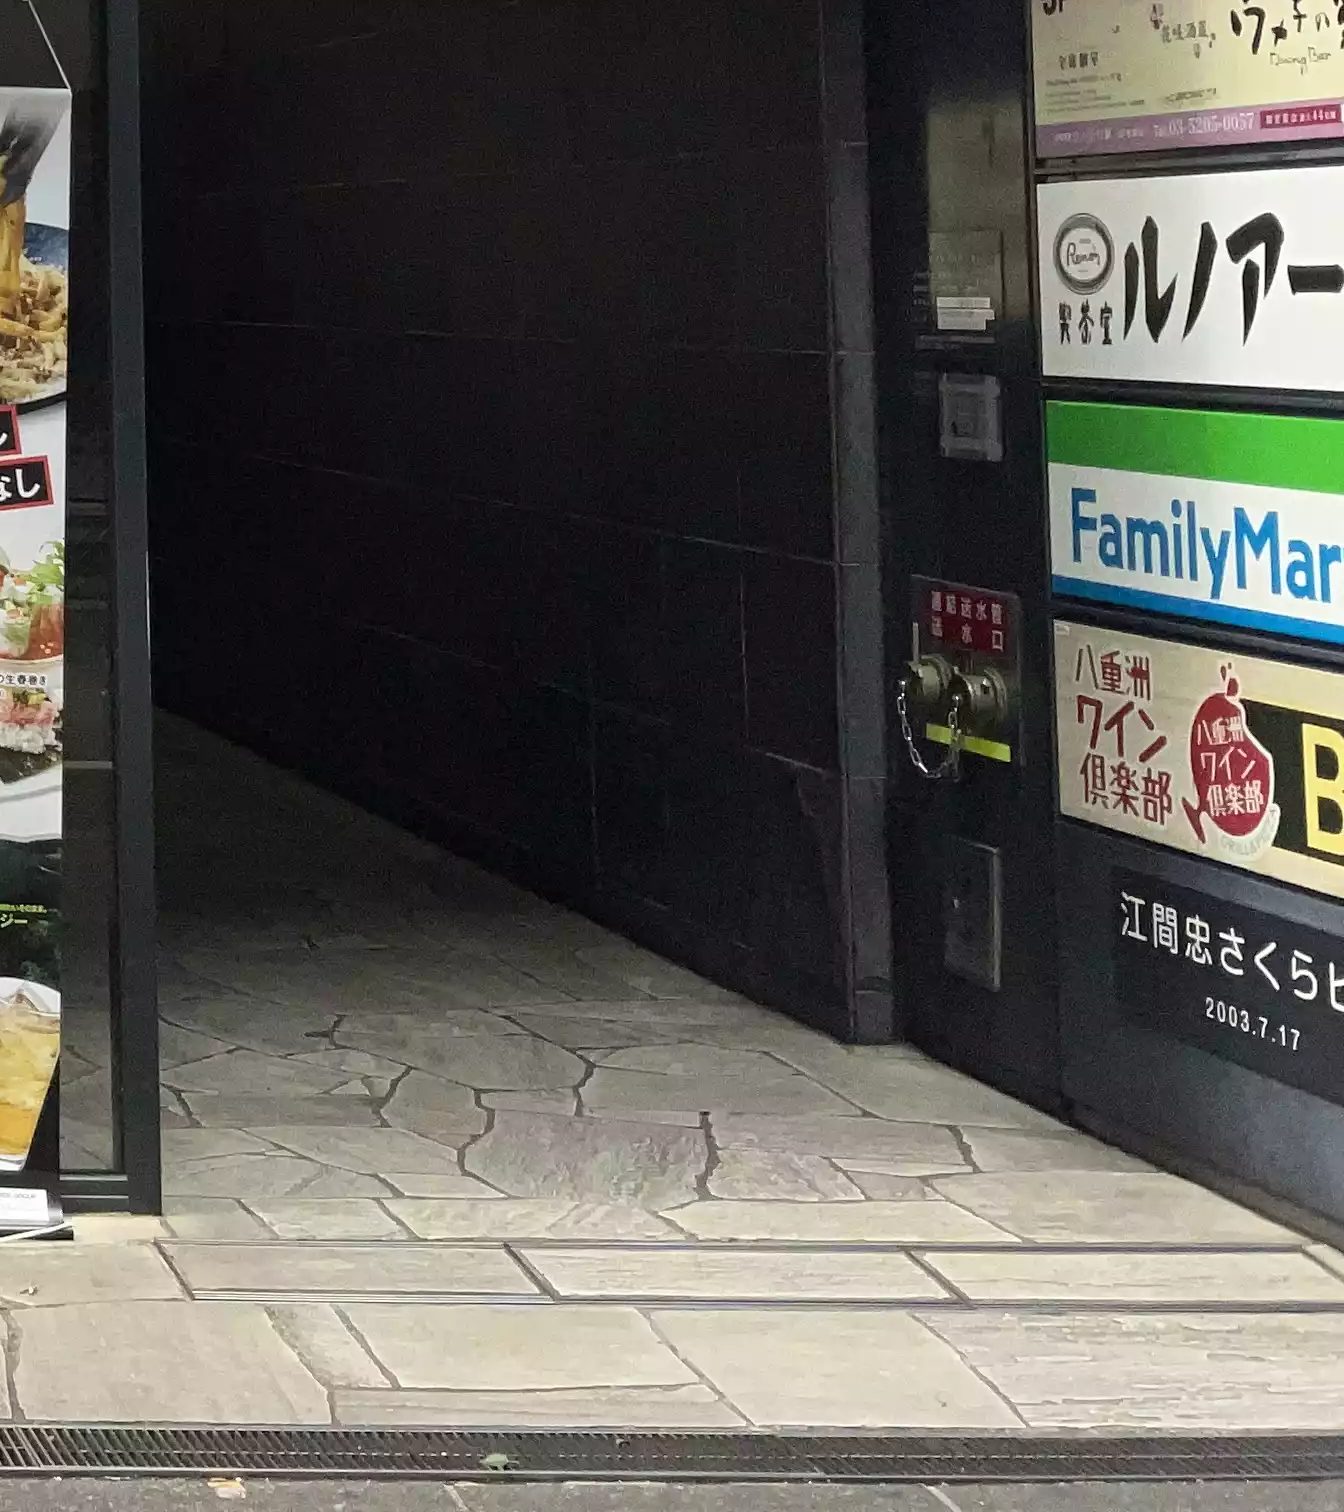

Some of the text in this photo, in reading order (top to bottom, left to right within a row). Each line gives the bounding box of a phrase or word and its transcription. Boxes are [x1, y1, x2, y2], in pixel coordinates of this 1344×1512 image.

[1123, 212, 1344, 347] ルノアー
[1076, 644, 1151, 701] 八重洲
[1077, 694, 1167, 763] ワイン
[1197, 715, 1244, 746] 八重洲
[1080, 752, 1172, 825] 倶楽部
[1201, 746, 1256, 781] ワイン
[1206, 780, 1264, 817] 倶楽部
[1206, 997, 1300, 1051] 2003.7.17
